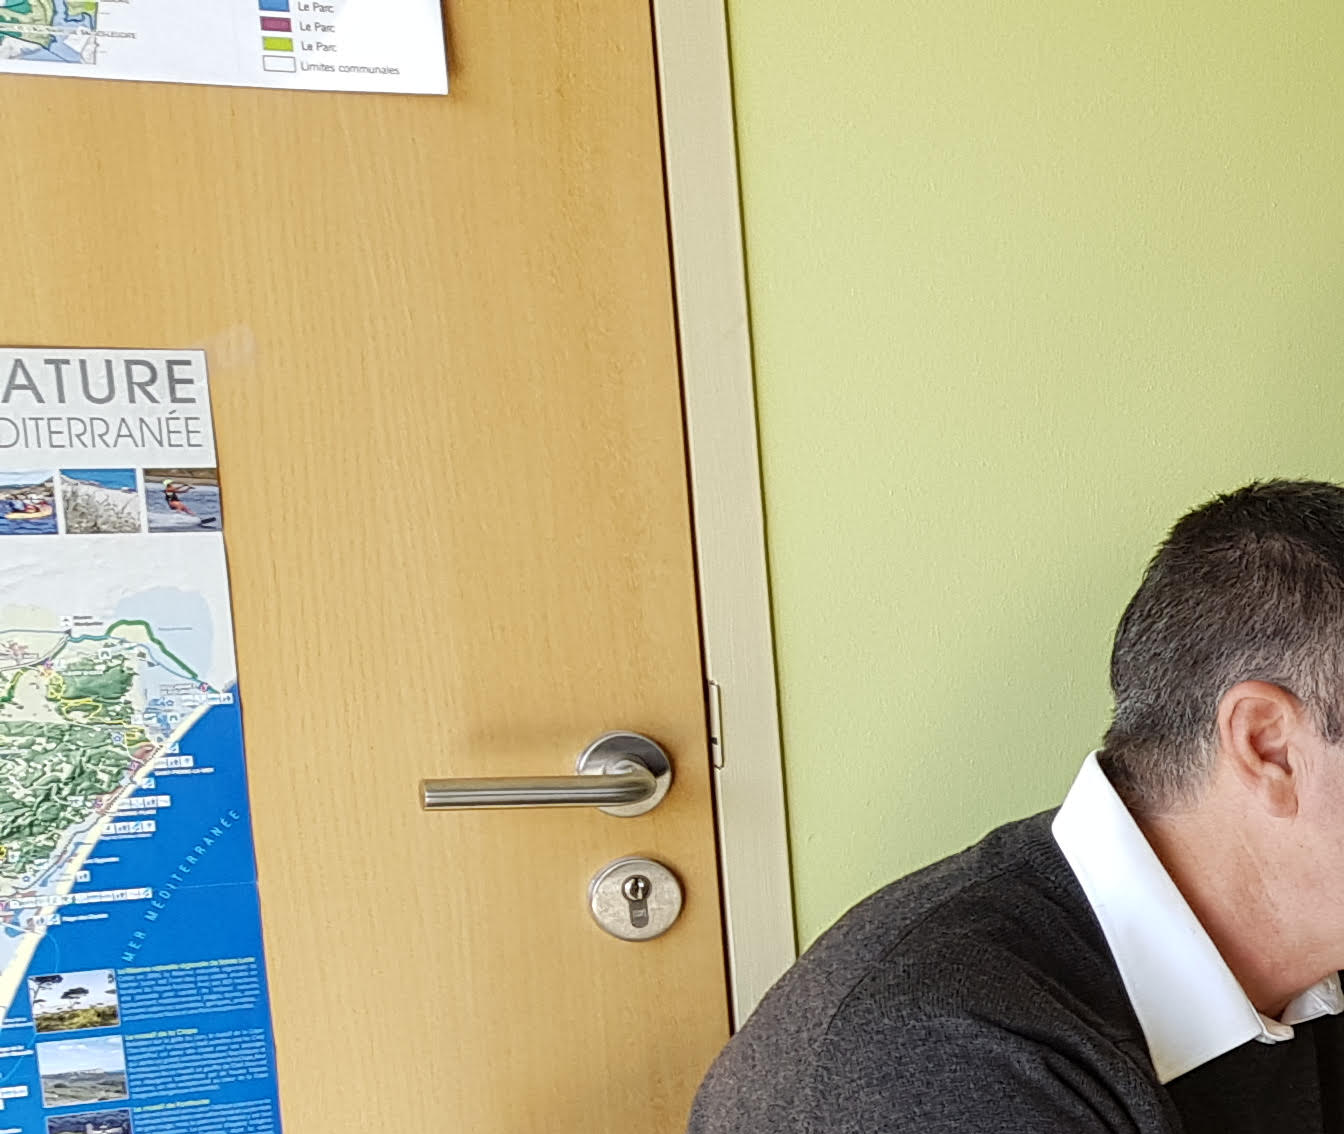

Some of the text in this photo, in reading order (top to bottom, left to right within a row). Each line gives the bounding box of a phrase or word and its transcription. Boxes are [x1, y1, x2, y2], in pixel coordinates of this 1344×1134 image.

[297, 2, 335, 14] Le Parc
[299, 21, 336, 33] Le Parc
[301, 41, 338, 53] Le Parc
[301, 61, 401, 75] Limites communales
[2, 358, 197, 405] ATURE
[121, 930, 147, 963] MER
